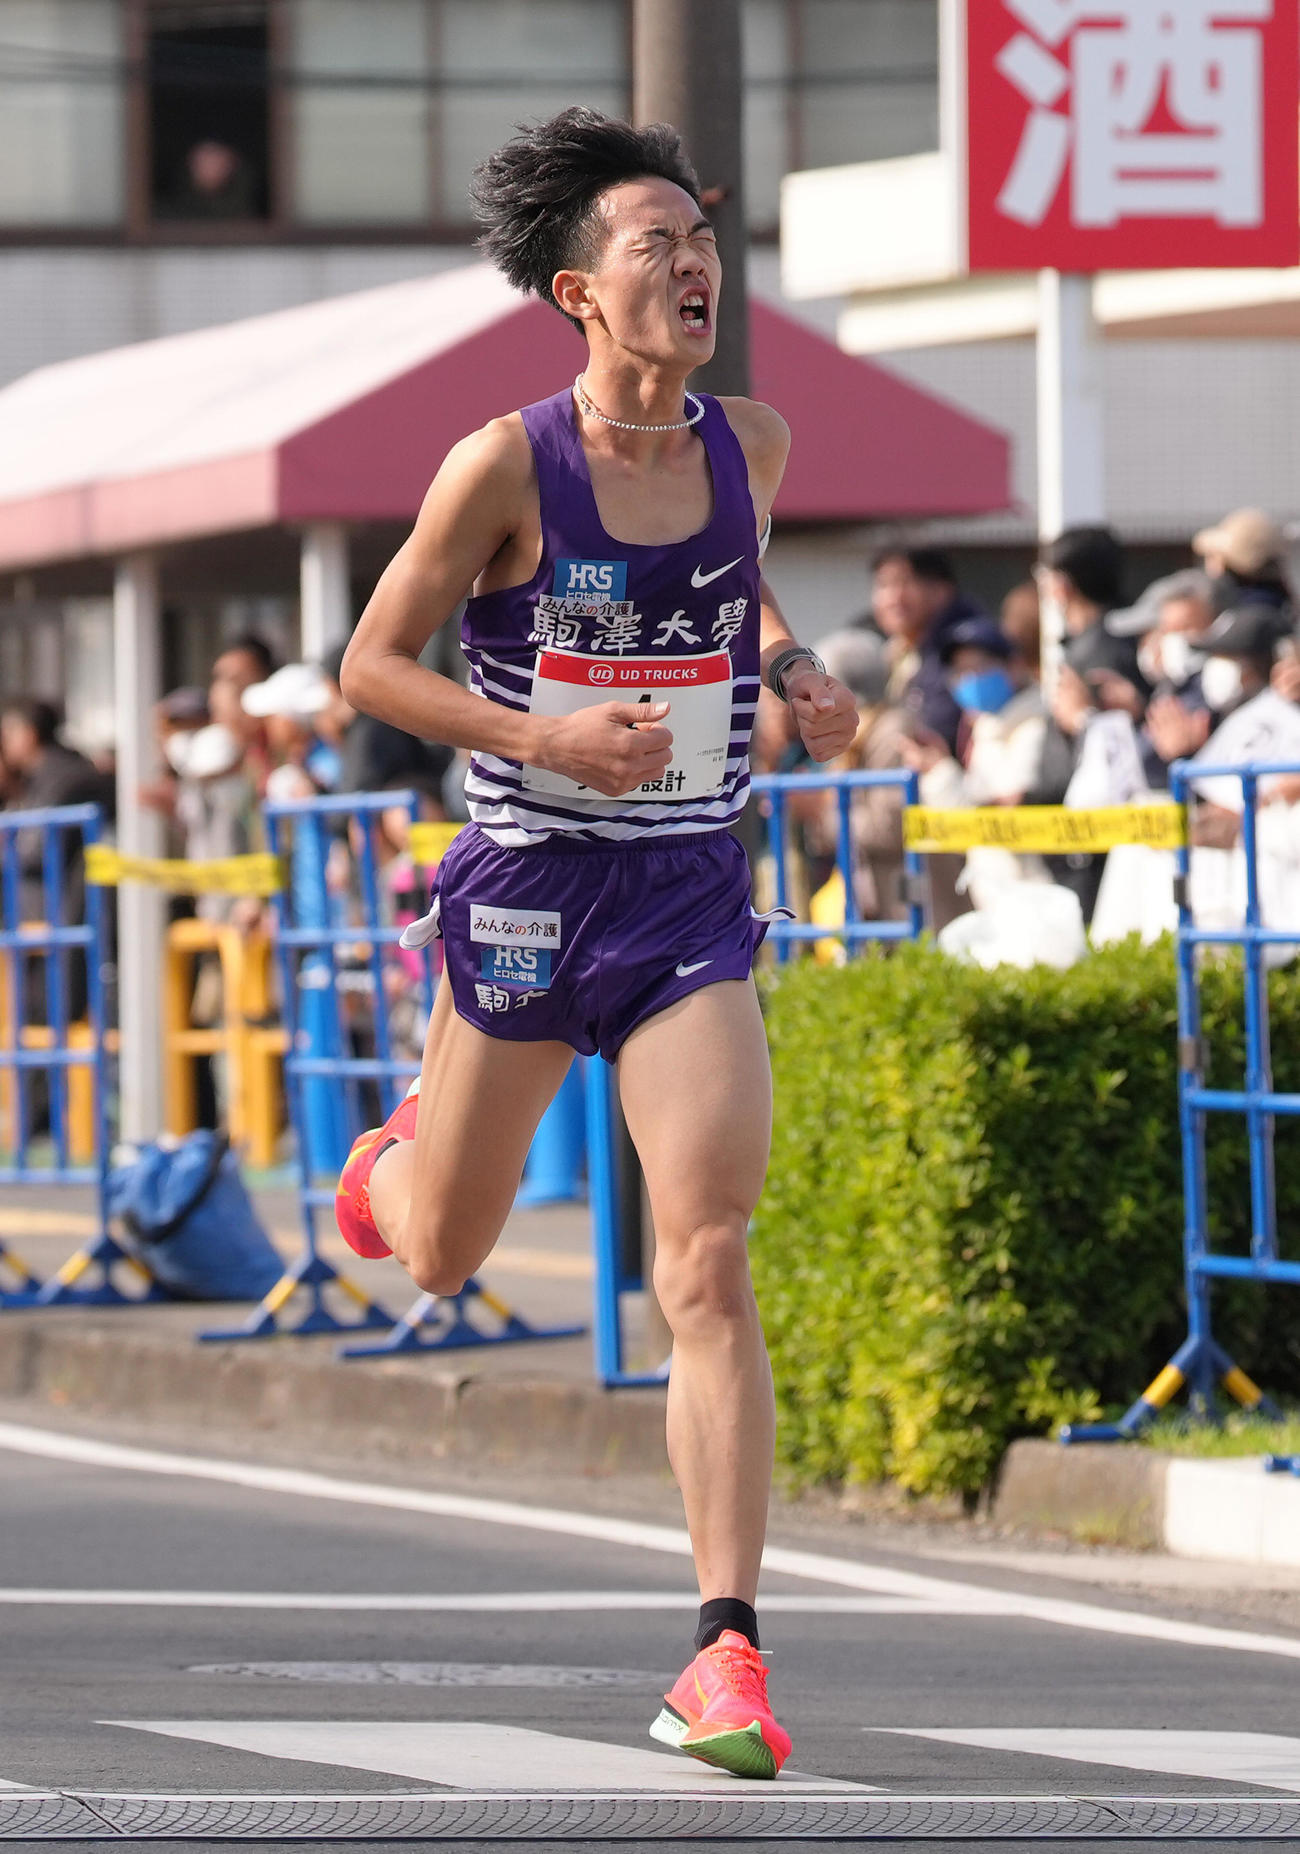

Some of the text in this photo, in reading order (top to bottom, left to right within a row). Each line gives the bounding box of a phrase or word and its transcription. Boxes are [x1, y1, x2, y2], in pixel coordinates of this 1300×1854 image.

[993, 0, 1275, 229] 酒
[567, 563, 614, 590] HRS
[543, 597, 630, 616] みんなの介護
[620, 669, 640, 680] UD
[644, 668, 699, 681] TRUCKS
[474, 917, 558, 938] みんなの介護
[494, 946, 538, 970] HRS
[493, 968, 537, 982] ヒロセ電機
